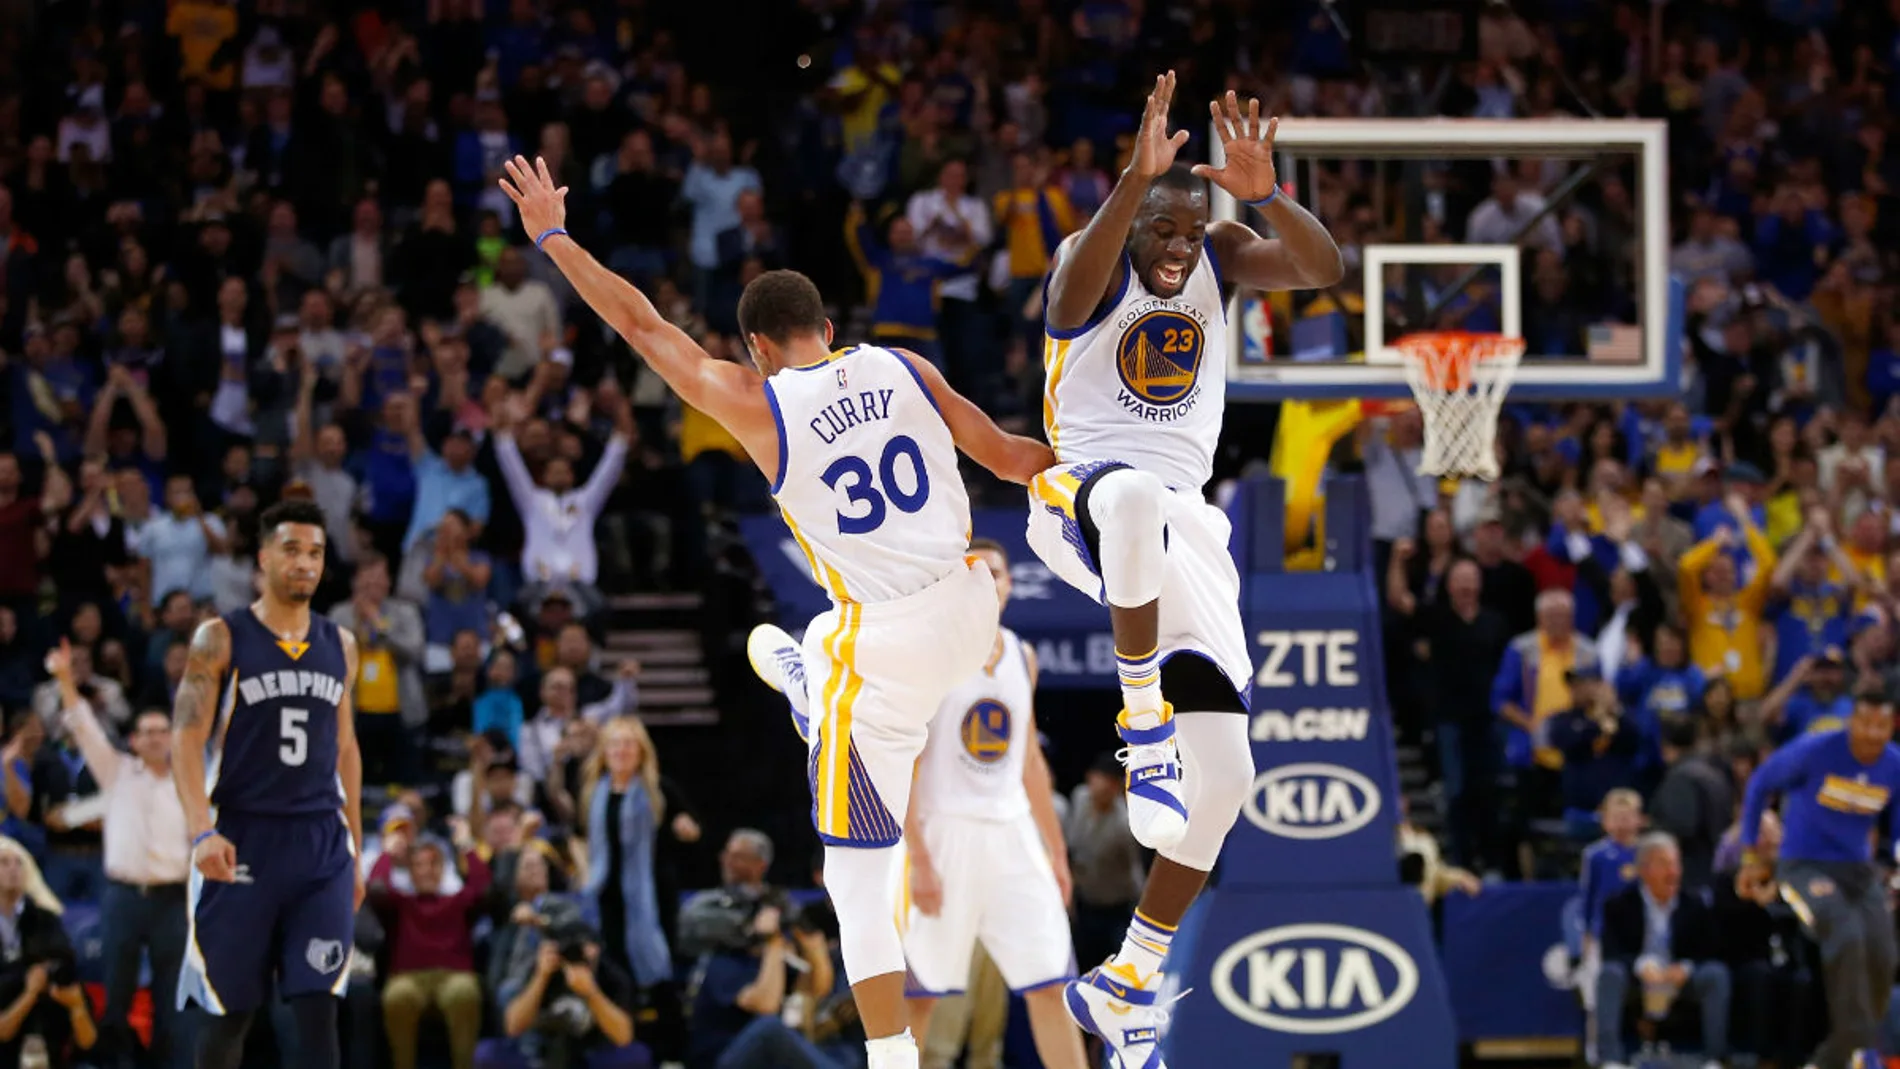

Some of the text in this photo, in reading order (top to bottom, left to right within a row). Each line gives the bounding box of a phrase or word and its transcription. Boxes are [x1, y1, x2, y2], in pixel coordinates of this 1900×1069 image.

[1118, 300, 1209, 330] GOLDEN STATE
[1162, 328, 1195, 353] 23
[809, 388, 894, 445] CURRY
[1117, 384, 1202, 422] WARRIORS
[819, 434, 931, 536] 30
[1036, 637, 1083, 675] AL
[1256, 628, 1360, 688] ZTE
[238, 669, 344, 707] MEMPHIS
[278, 706, 310, 767] 5
[1292, 705, 1371, 741] CSN
[1264, 777, 1359, 823] KIA
[1248, 946, 1387, 1011] KIA
